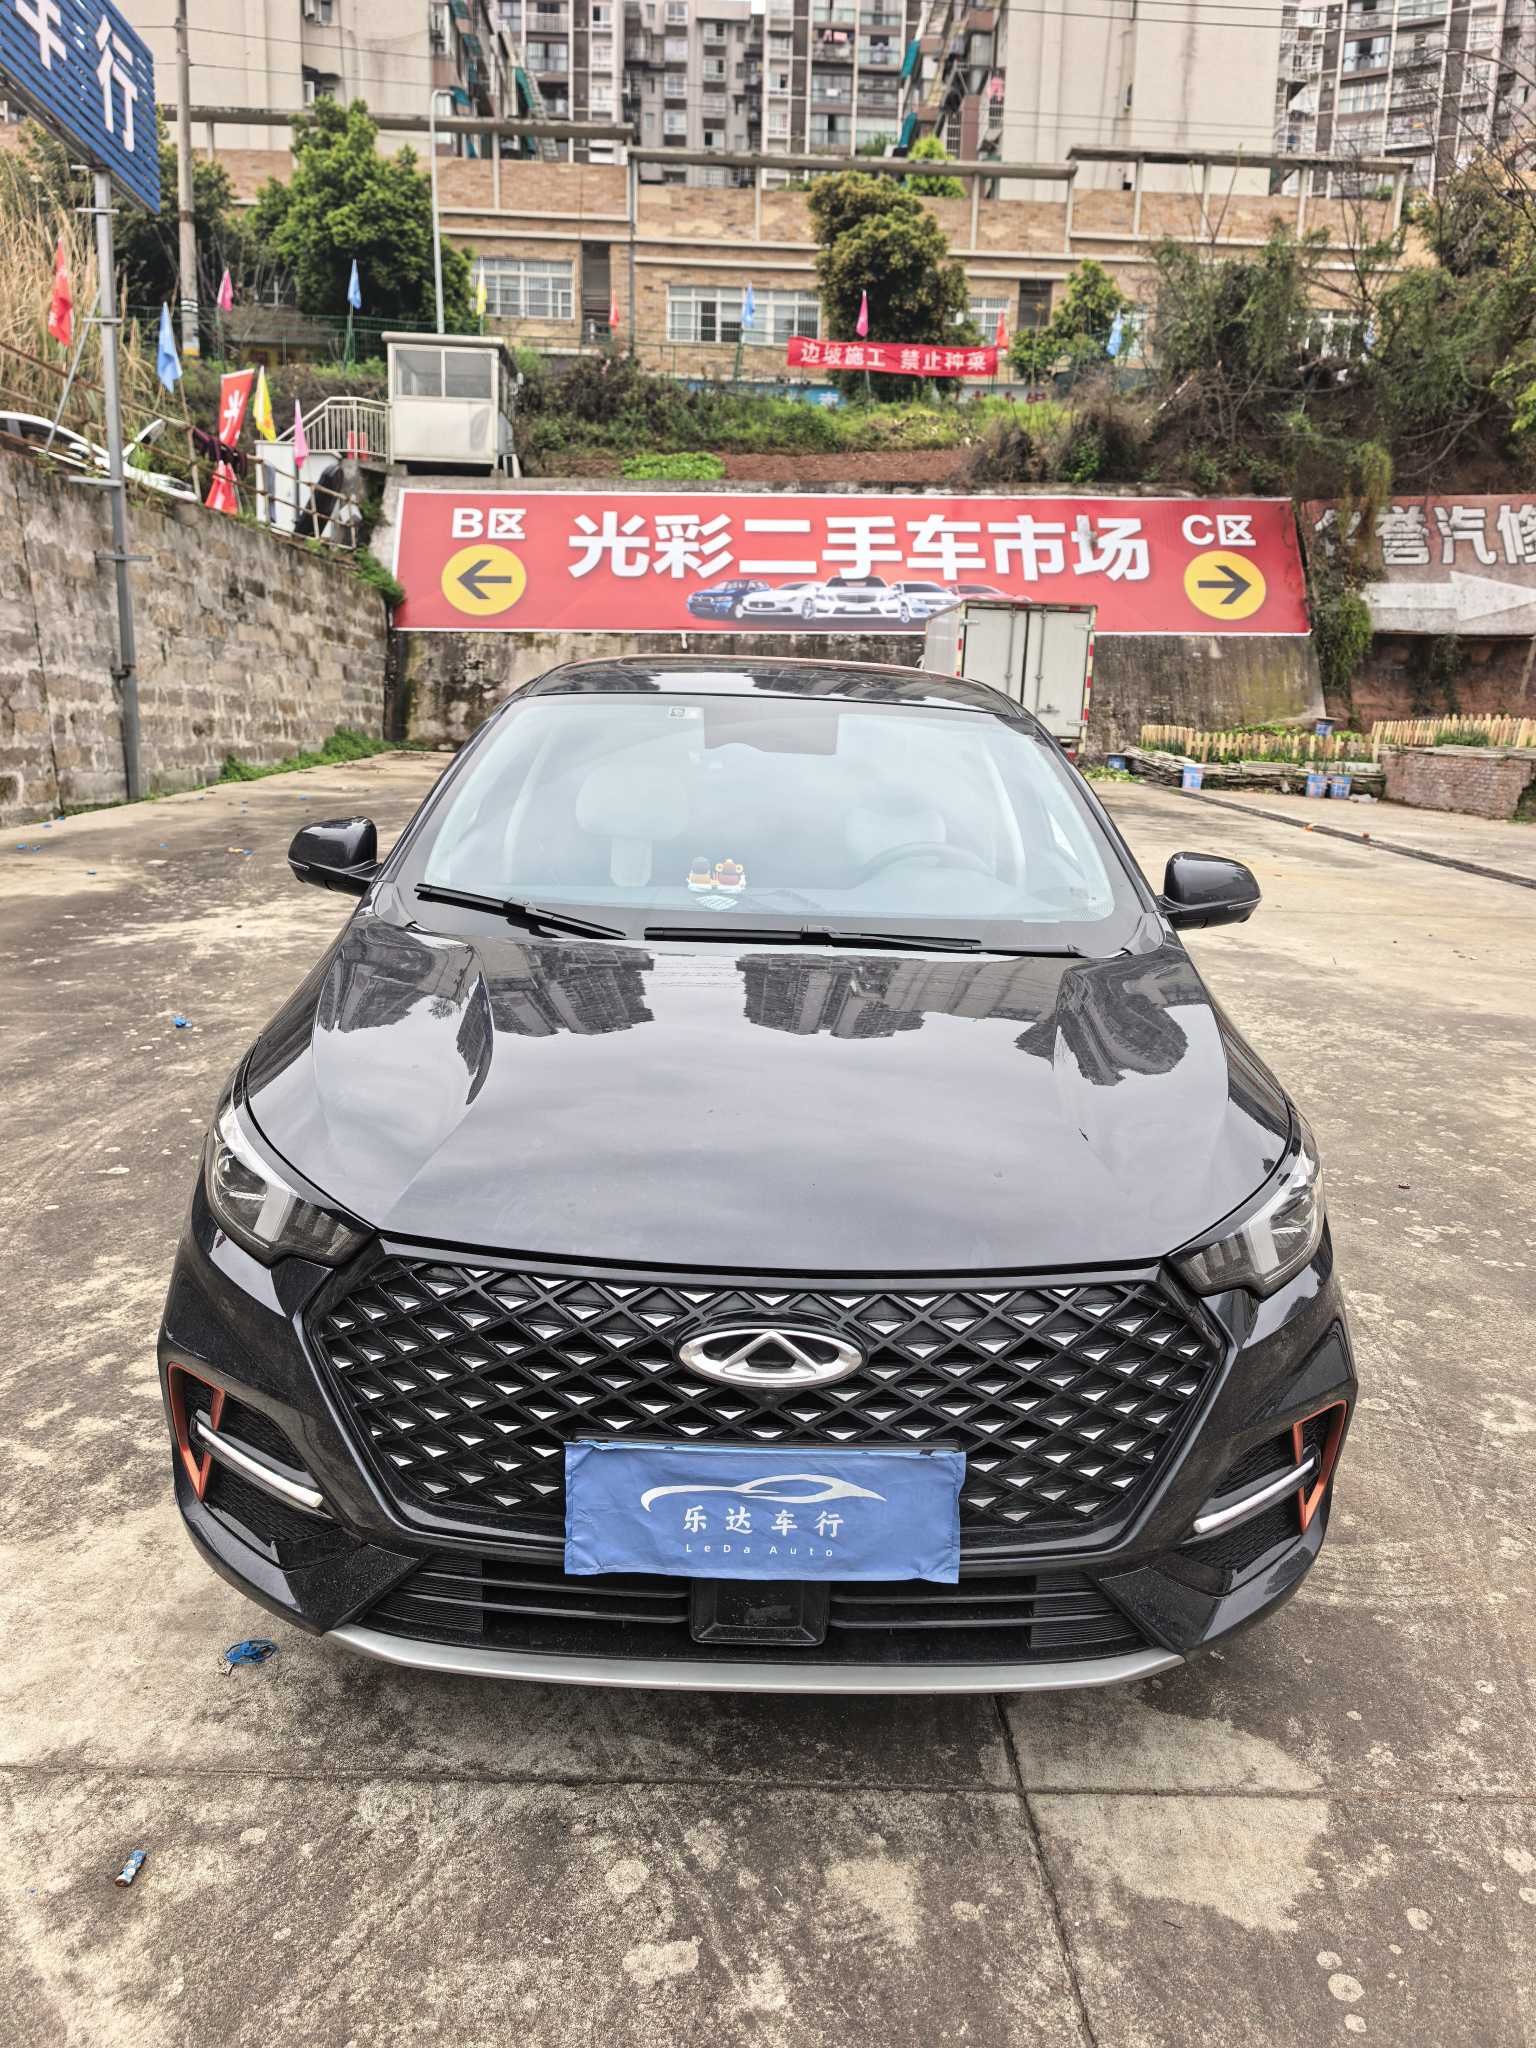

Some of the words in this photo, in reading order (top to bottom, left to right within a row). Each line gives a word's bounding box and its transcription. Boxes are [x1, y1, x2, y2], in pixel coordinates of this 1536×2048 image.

[452, 508, 527, 540] B区
[1182, 514, 1256, 546] C区
[568, 511, 1150, 581] 光彩二手车市场
[683, 1505, 844, 1538] 乐达车行
[686, 1543, 751, 1555] LeDa
[769, 1546, 833, 1557] Auto
